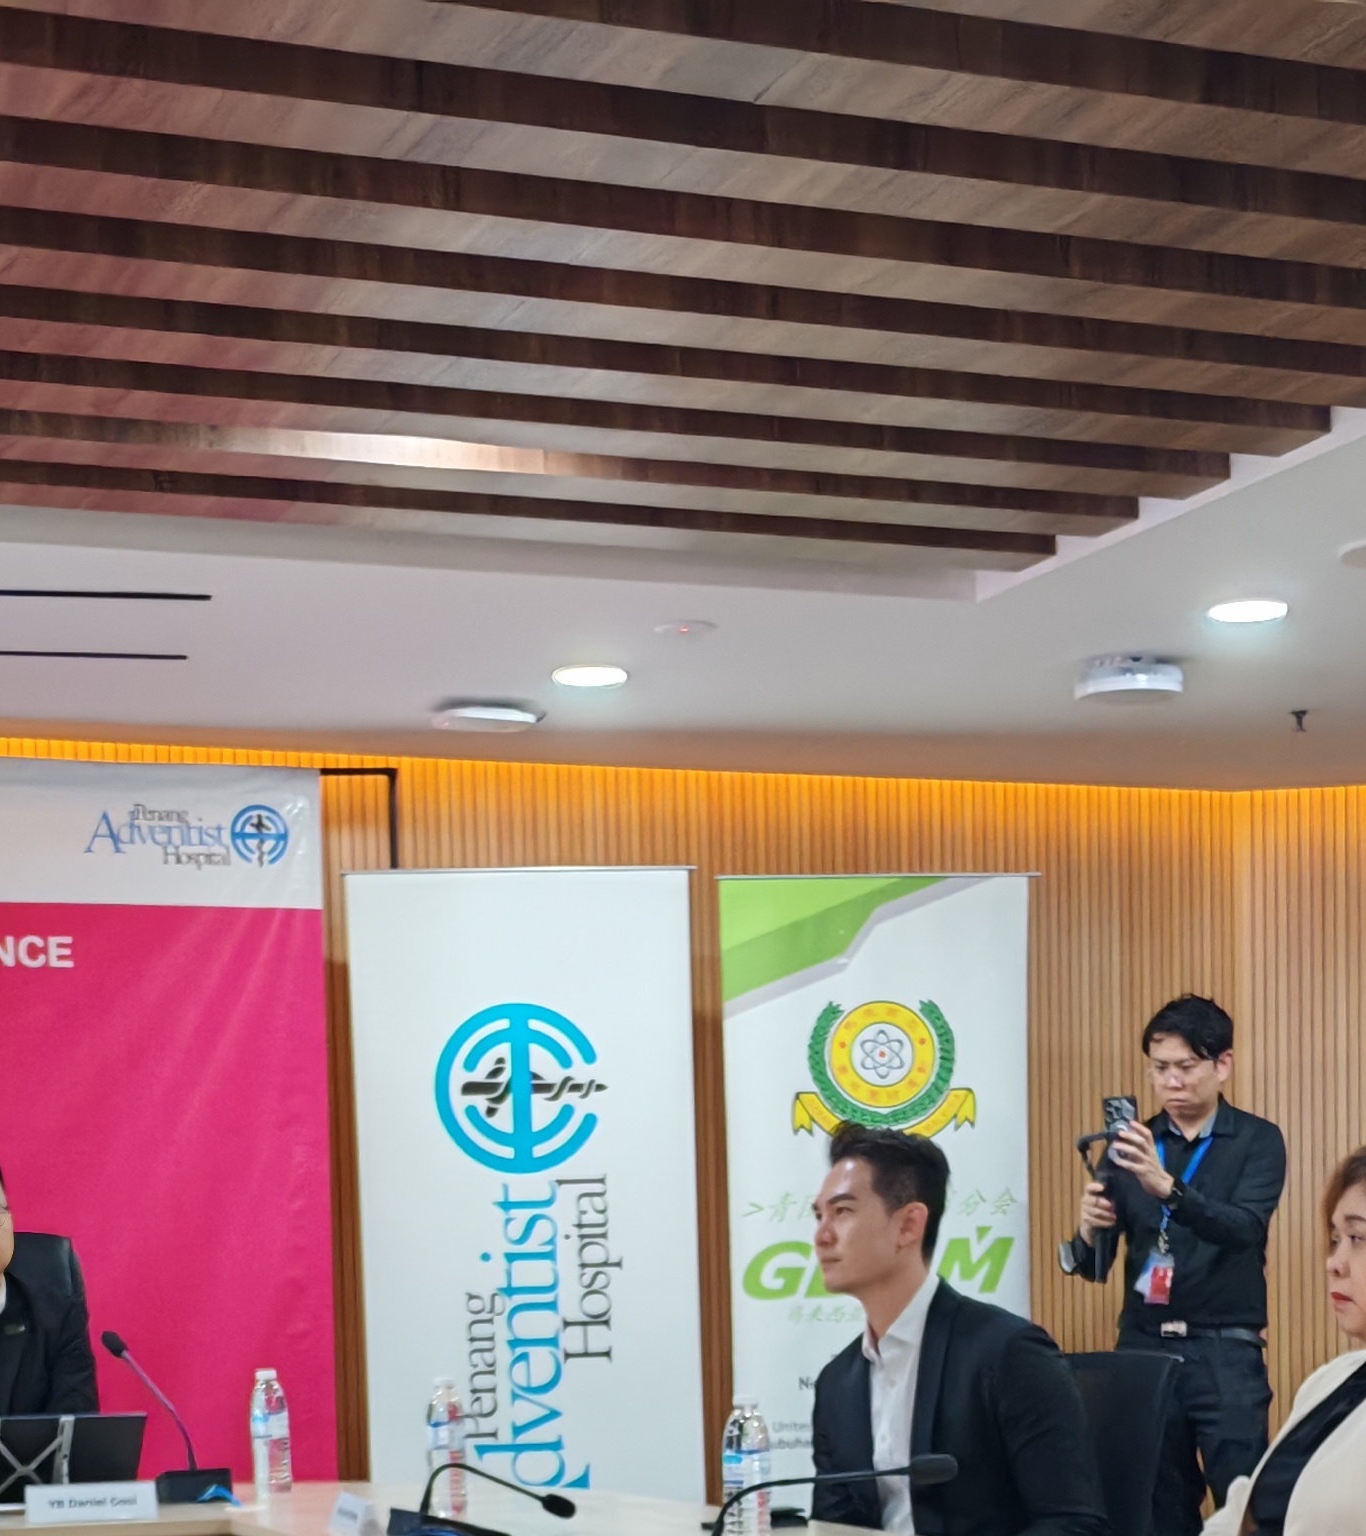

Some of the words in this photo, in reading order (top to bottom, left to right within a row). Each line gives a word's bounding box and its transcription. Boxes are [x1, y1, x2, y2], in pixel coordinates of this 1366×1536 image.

[473, 1180, 591, 1490] dventist
[554, 1173, 623, 1363] Hospital
[741, 1226, 1015, 1300] GM
